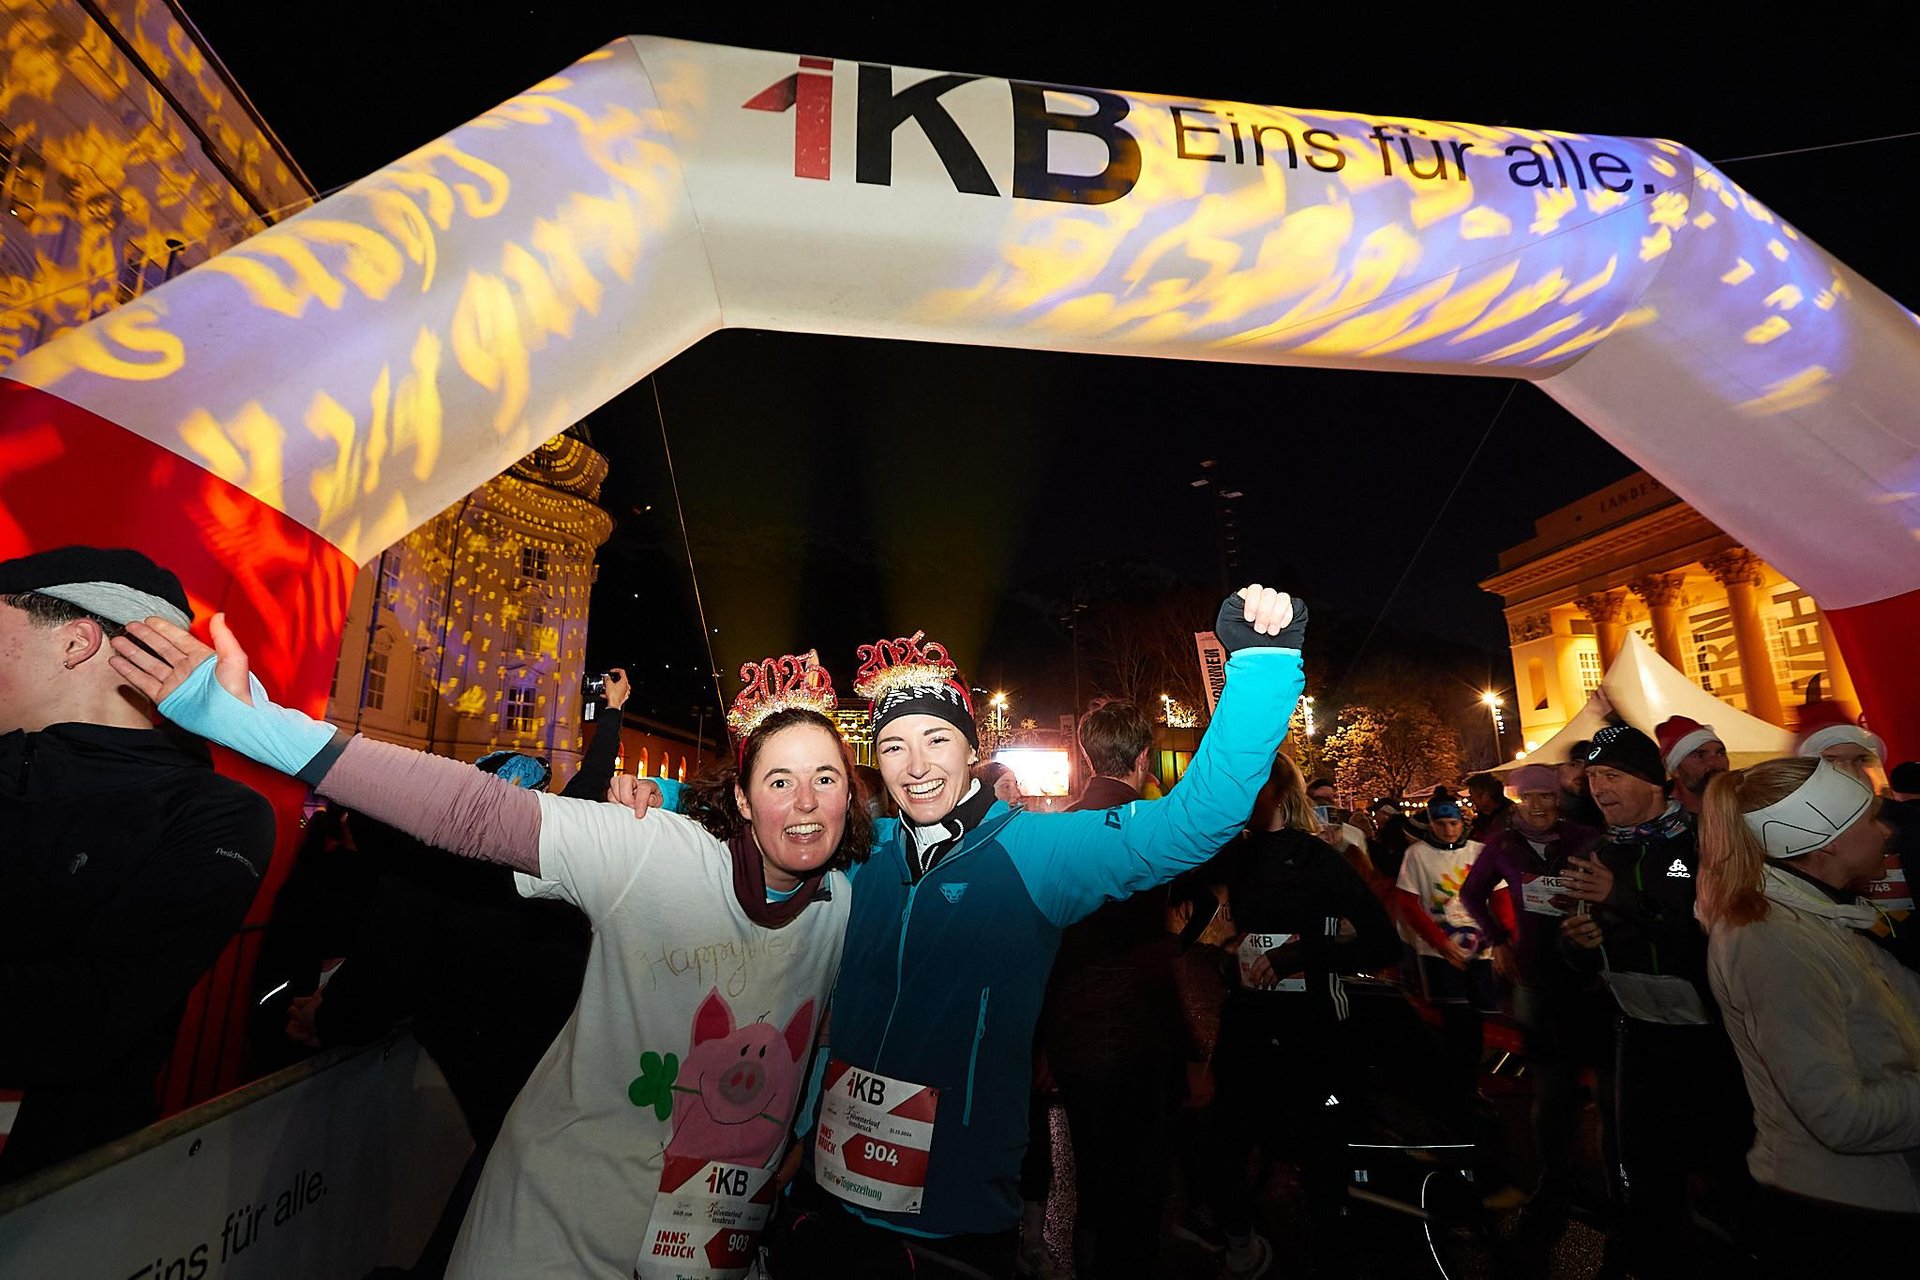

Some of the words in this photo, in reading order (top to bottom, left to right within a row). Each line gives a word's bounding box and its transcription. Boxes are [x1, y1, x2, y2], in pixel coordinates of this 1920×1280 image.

[1170, 105, 1347, 173] Eins
[1369, 124, 1474, 182] für
[1505, 139, 1656, 195] alle.
[863, 1141, 899, 1167] 904
[840, 1175, 882, 1201] Tageszeitung
[221, 1204, 267, 1264] für
[274, 1168, 328, 1228] alle.
[656, 1230, 690, 1244] INNS'
[652, 1243, 696, 1259] BRUCK
